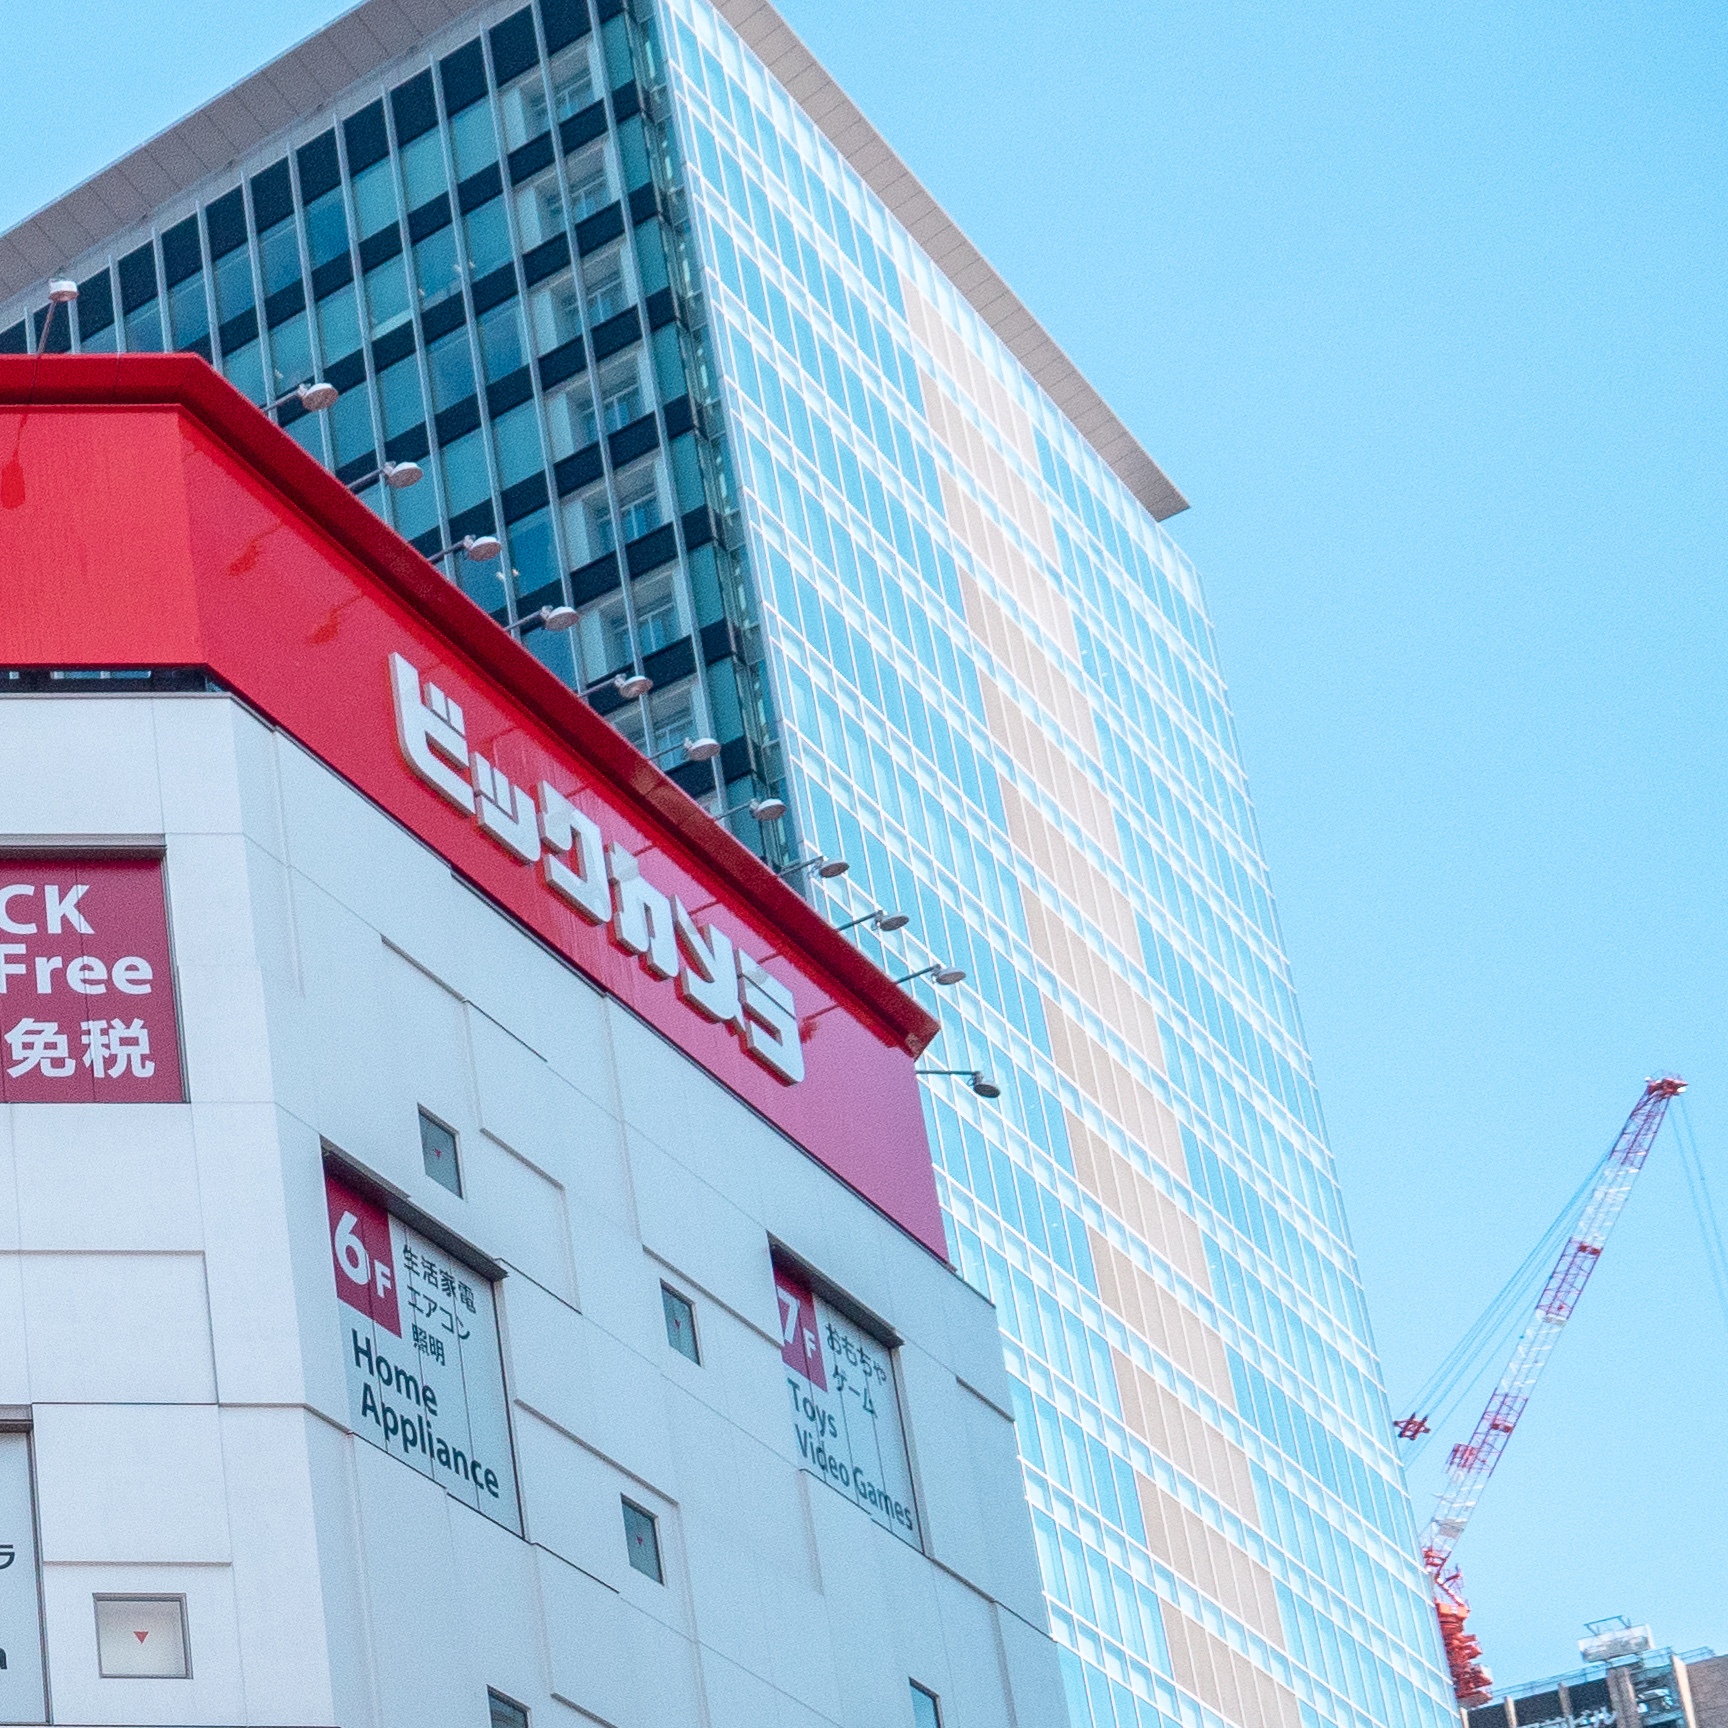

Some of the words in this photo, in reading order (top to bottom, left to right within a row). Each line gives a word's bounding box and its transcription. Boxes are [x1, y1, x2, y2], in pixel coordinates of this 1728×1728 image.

[389, 652, 805, 1086] ビックカメラ
[335, 1210, 392, 1297] 6F
[402, 1244, 477, 1314] 生活家電
[407, 1284, 471, 1340] エアコン
[411, 1322, 446, 1366] 照明
[778, 1285, 817, 1359] 7F
[351, 1327, 438, 1417] Home
[826, 1322, 887, 1386] おもちゃ
[361, 1381, 500, 1498] Appliance
[787, 1377, 838, 1438] Toys
[795, 1423, 850, 1488] Video
[852, 1466, 913, 1531] Games
